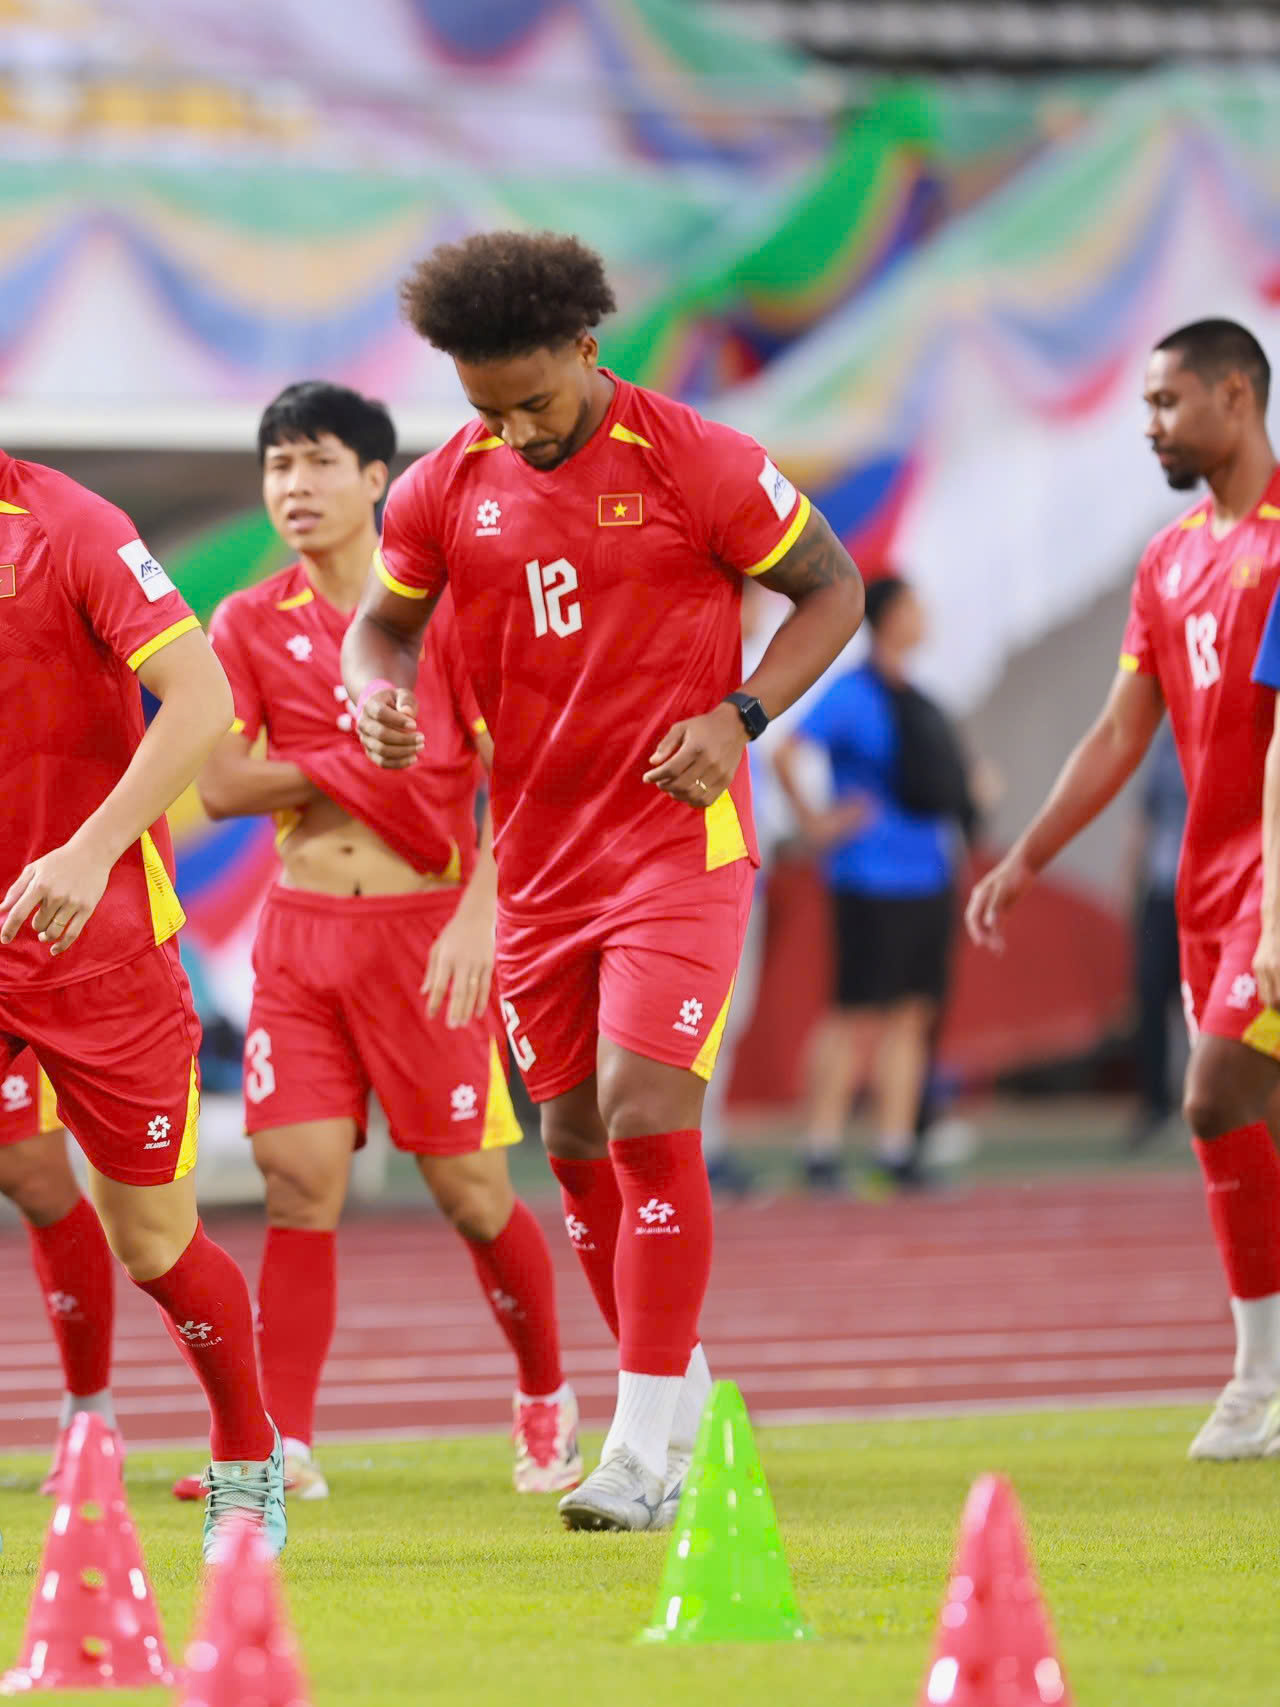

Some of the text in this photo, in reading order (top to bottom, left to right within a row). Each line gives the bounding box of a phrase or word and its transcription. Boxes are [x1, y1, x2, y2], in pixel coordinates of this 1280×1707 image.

[525, 557, 582, 638] 12
[1184, 611, 1221, 690] 13
[247, 1028, 276, 1104] 3
